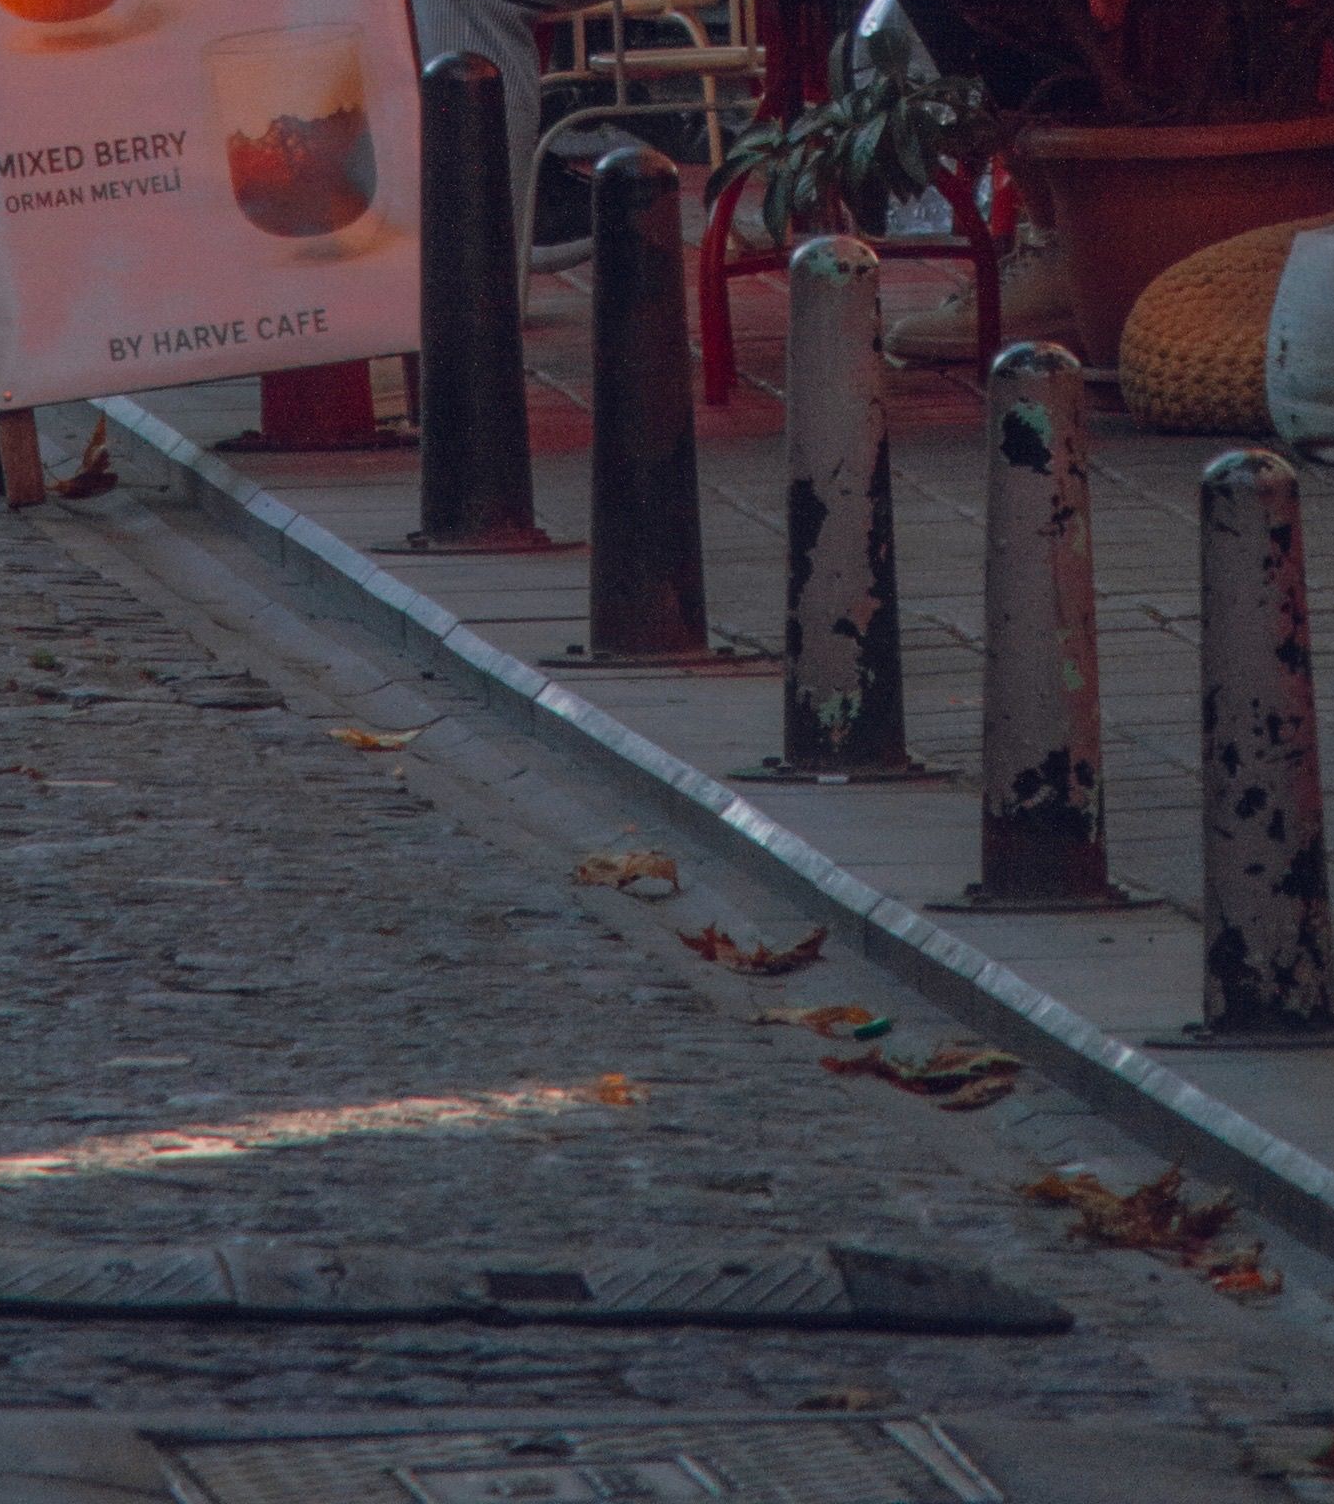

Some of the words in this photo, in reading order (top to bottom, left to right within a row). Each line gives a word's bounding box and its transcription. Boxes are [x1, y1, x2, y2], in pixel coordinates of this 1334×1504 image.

[94, 130, 189, 171] BERRY
[4, 182, 85, 215] ORMAN
[89, 168, 182, 204] MEYVELİ
[108, 335, 142, 363] BY
[153, 321, 248, 356] HARVE
[256, 309, 329, 343] CAFE
